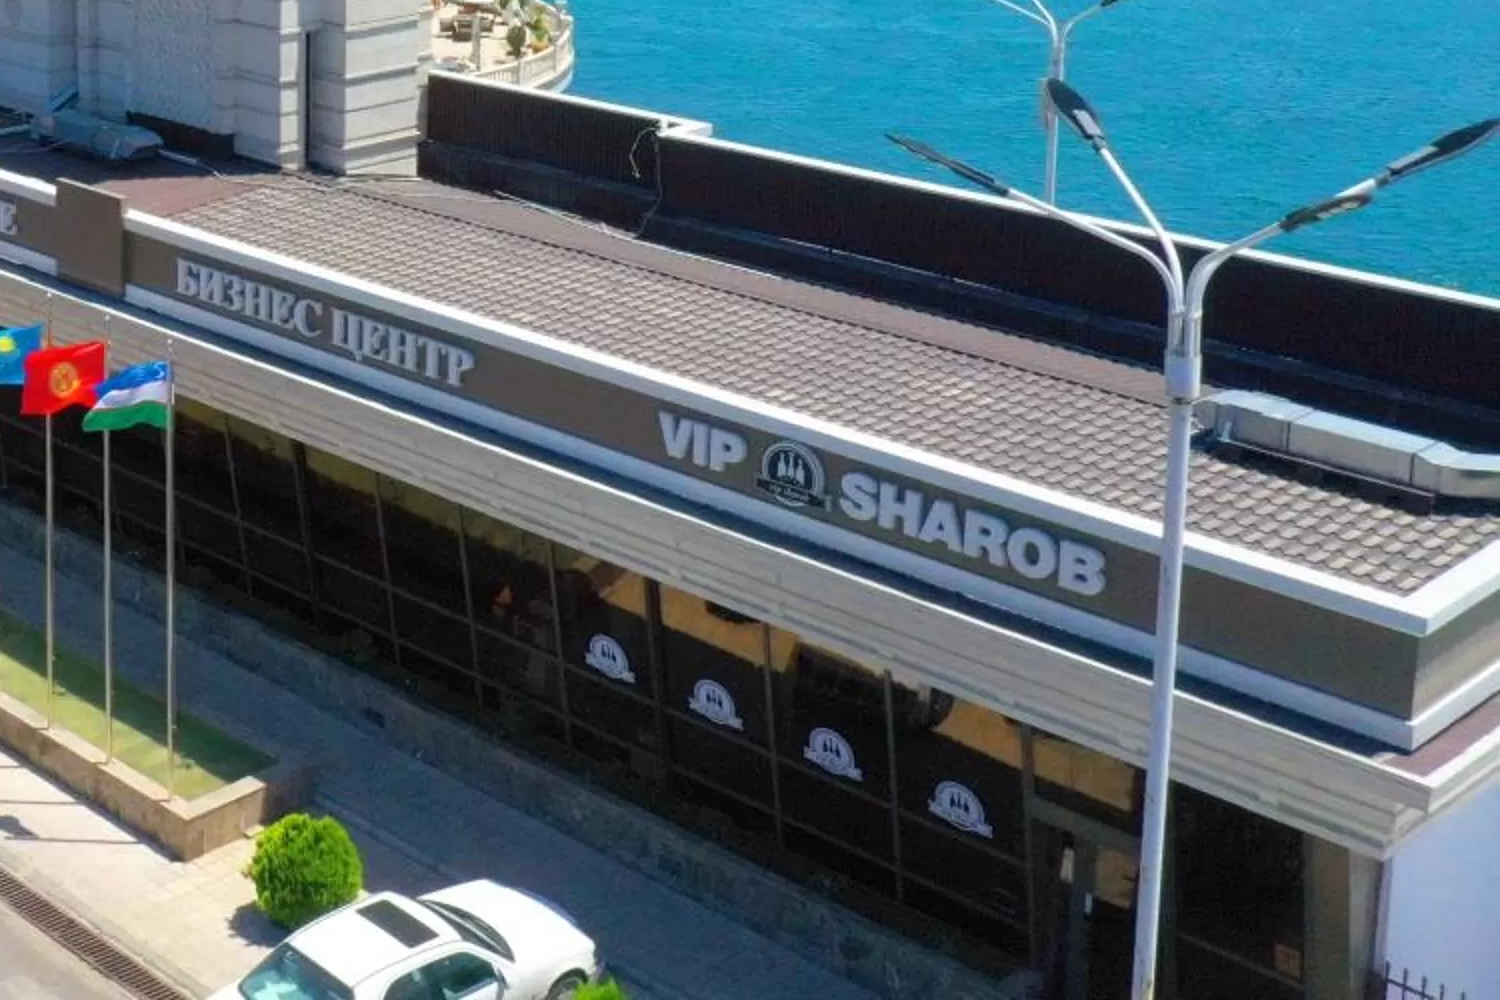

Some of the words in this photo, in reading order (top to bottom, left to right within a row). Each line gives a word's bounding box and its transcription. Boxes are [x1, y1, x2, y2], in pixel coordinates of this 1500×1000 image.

[176, 258, 323, 338] БИЗНЕС
[331, 309, 476, 387] ЦЕНТР
[658, 411, 748, 472] VIP
[839, 472, 1107, 597] SHAROB
